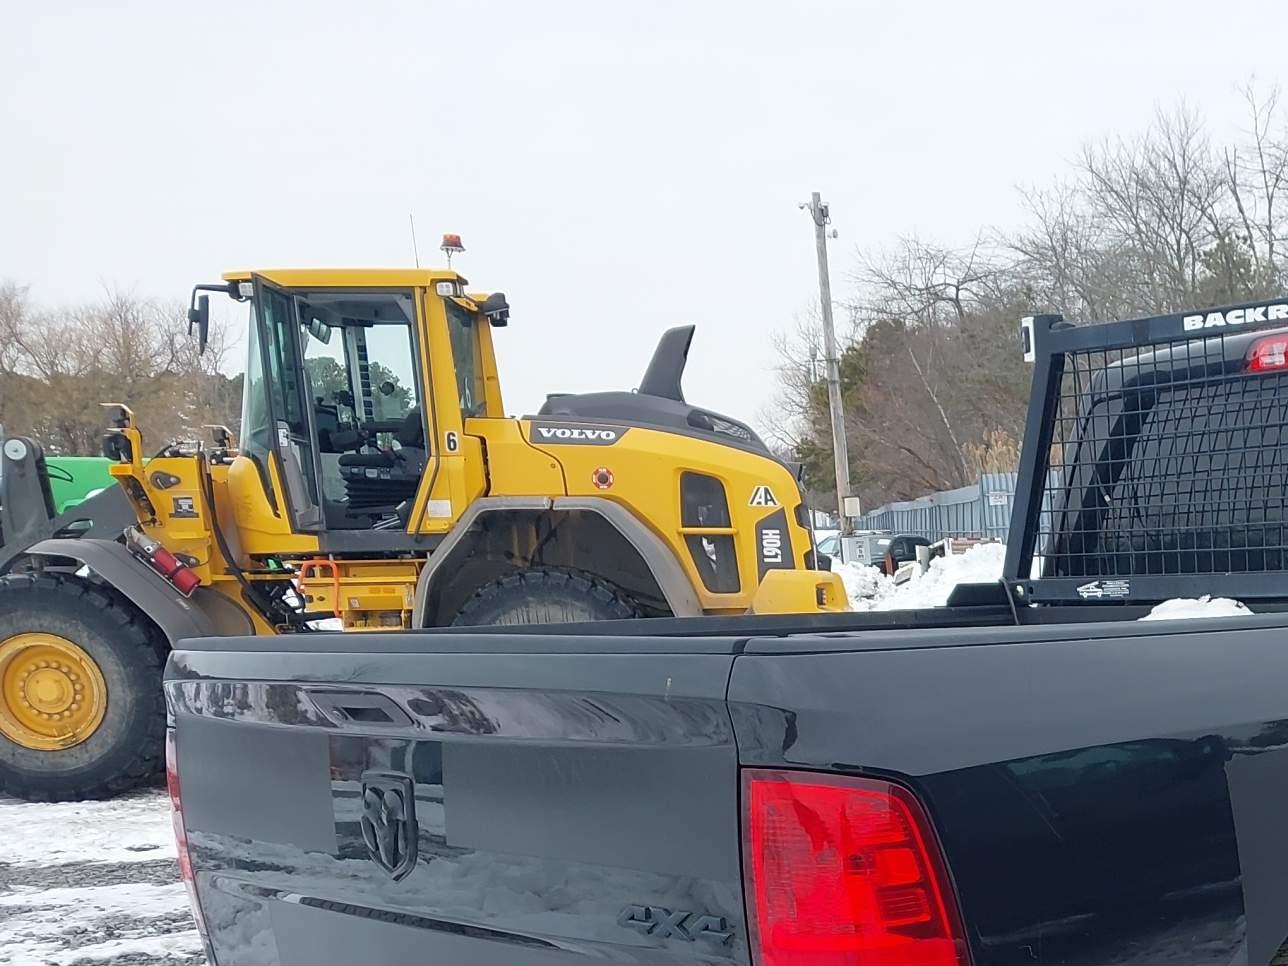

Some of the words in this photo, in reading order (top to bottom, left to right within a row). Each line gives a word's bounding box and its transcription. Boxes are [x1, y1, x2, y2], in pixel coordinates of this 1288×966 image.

[446, 432, 457, 452] 6
[537, 427, 616, 440] VOLVO
[762, 529, 782, 563] L90H
